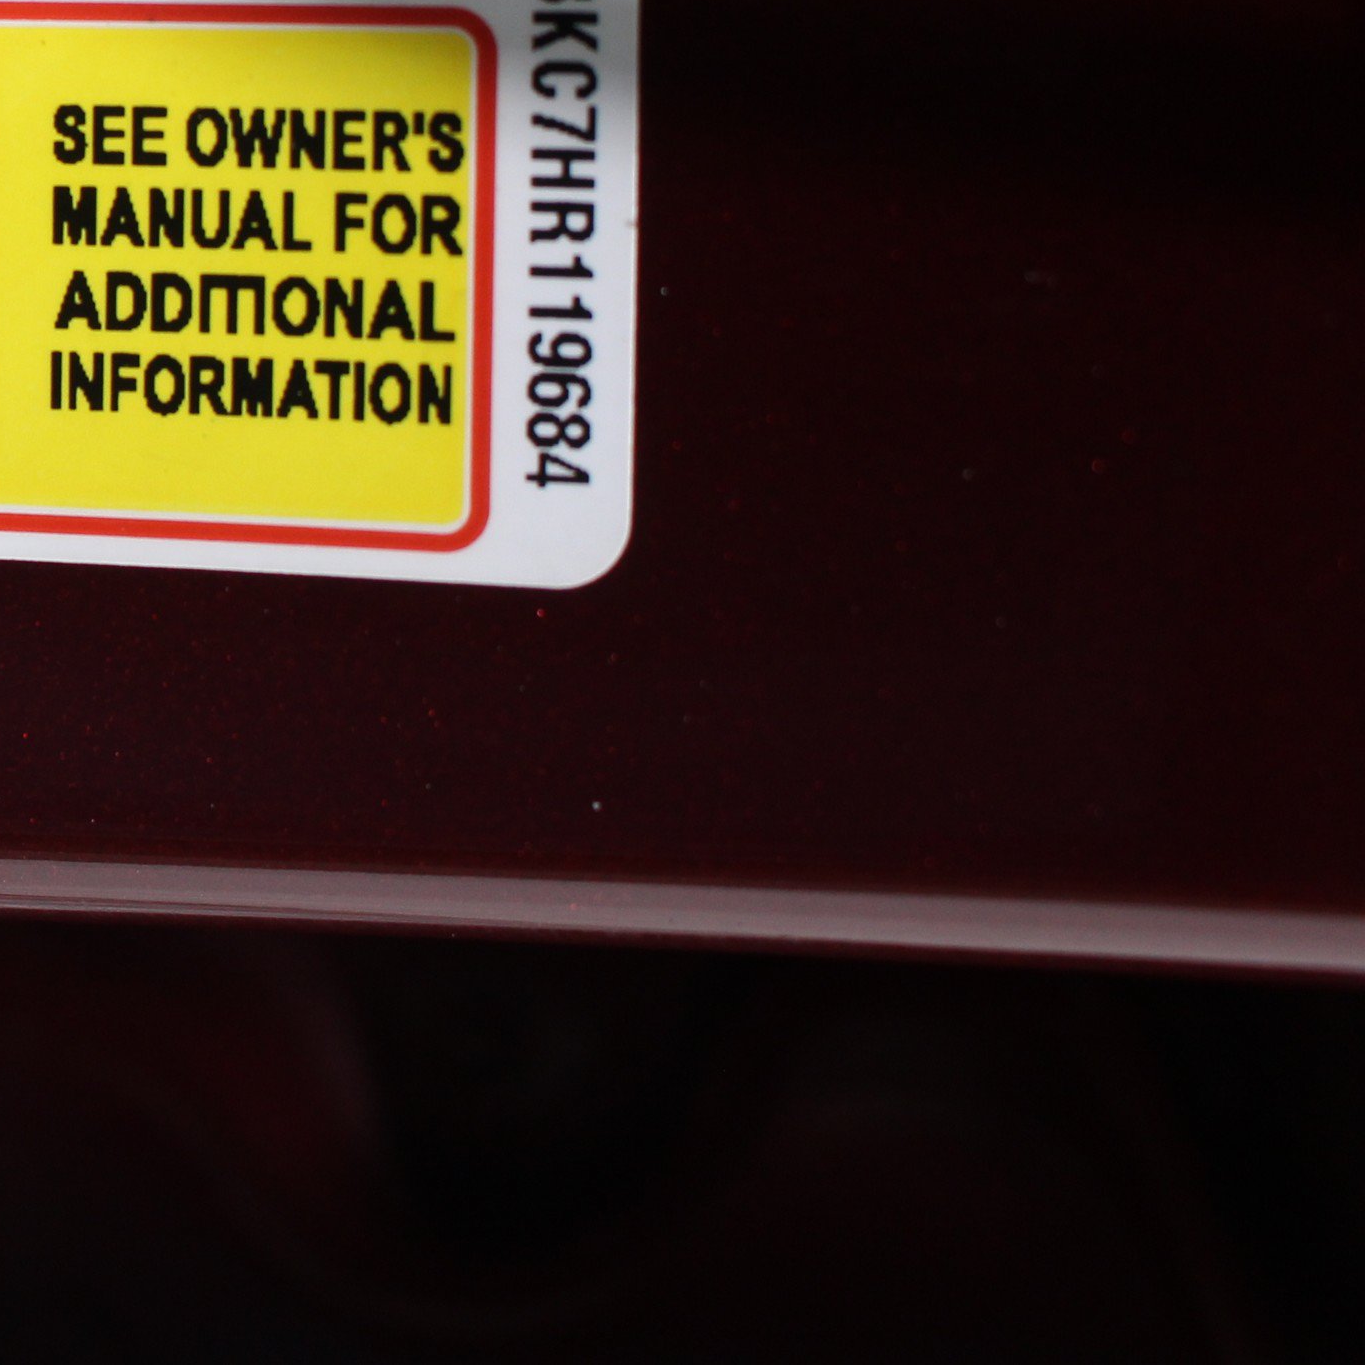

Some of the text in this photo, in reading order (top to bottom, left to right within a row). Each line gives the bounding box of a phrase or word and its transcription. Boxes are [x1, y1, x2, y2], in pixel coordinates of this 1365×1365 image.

[54, 105, 464, 172] SEE OWNER'S
[53, 186, 462, 255] MANUAL FOR
[56, 271, 455, 341] ADDITIONAL
[52, 352, 451, 424] INFORMATION
